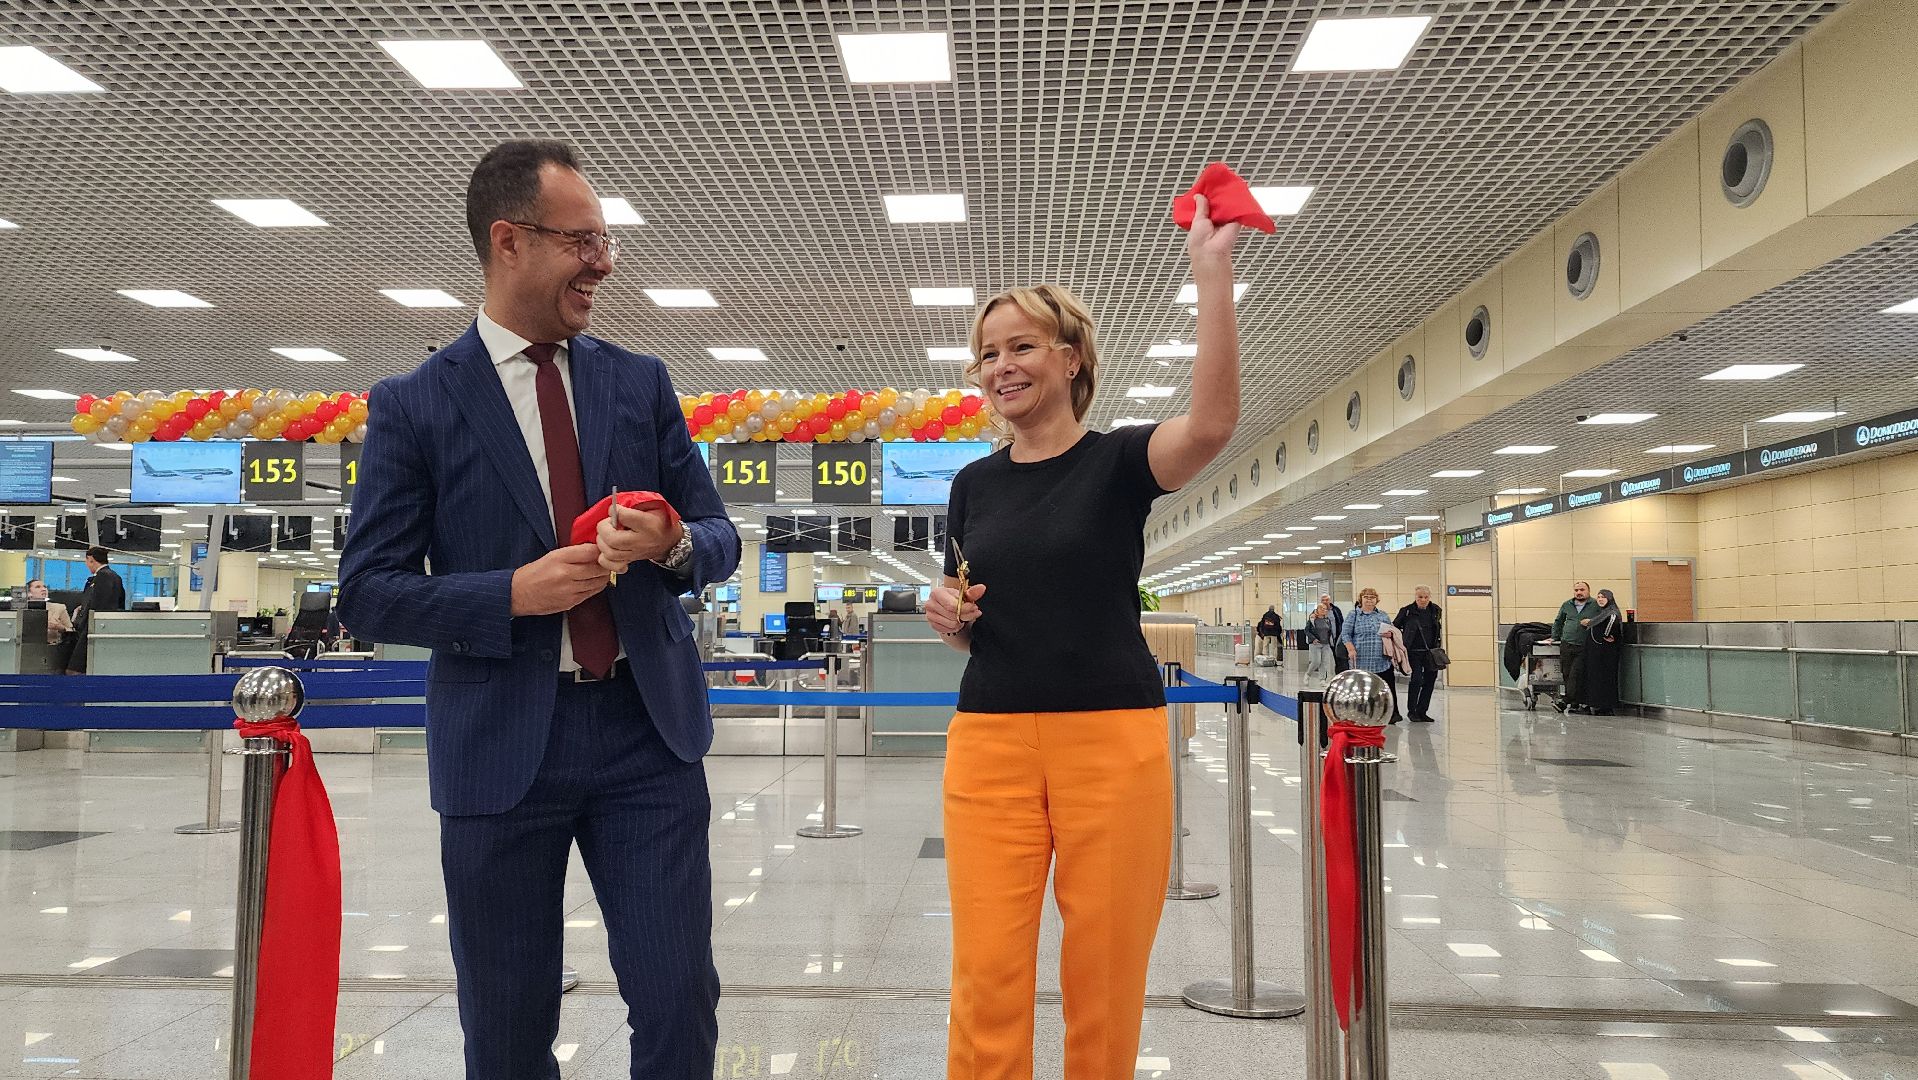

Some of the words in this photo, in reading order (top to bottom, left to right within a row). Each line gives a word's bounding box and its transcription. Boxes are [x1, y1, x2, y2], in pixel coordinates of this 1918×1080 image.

[1772, 442, 1818, 461] DOMODEDOVO
[250, 459, 297, 483] 153
[722, 460, 770, 484] 151
[817, 461, 867, 485] 150
